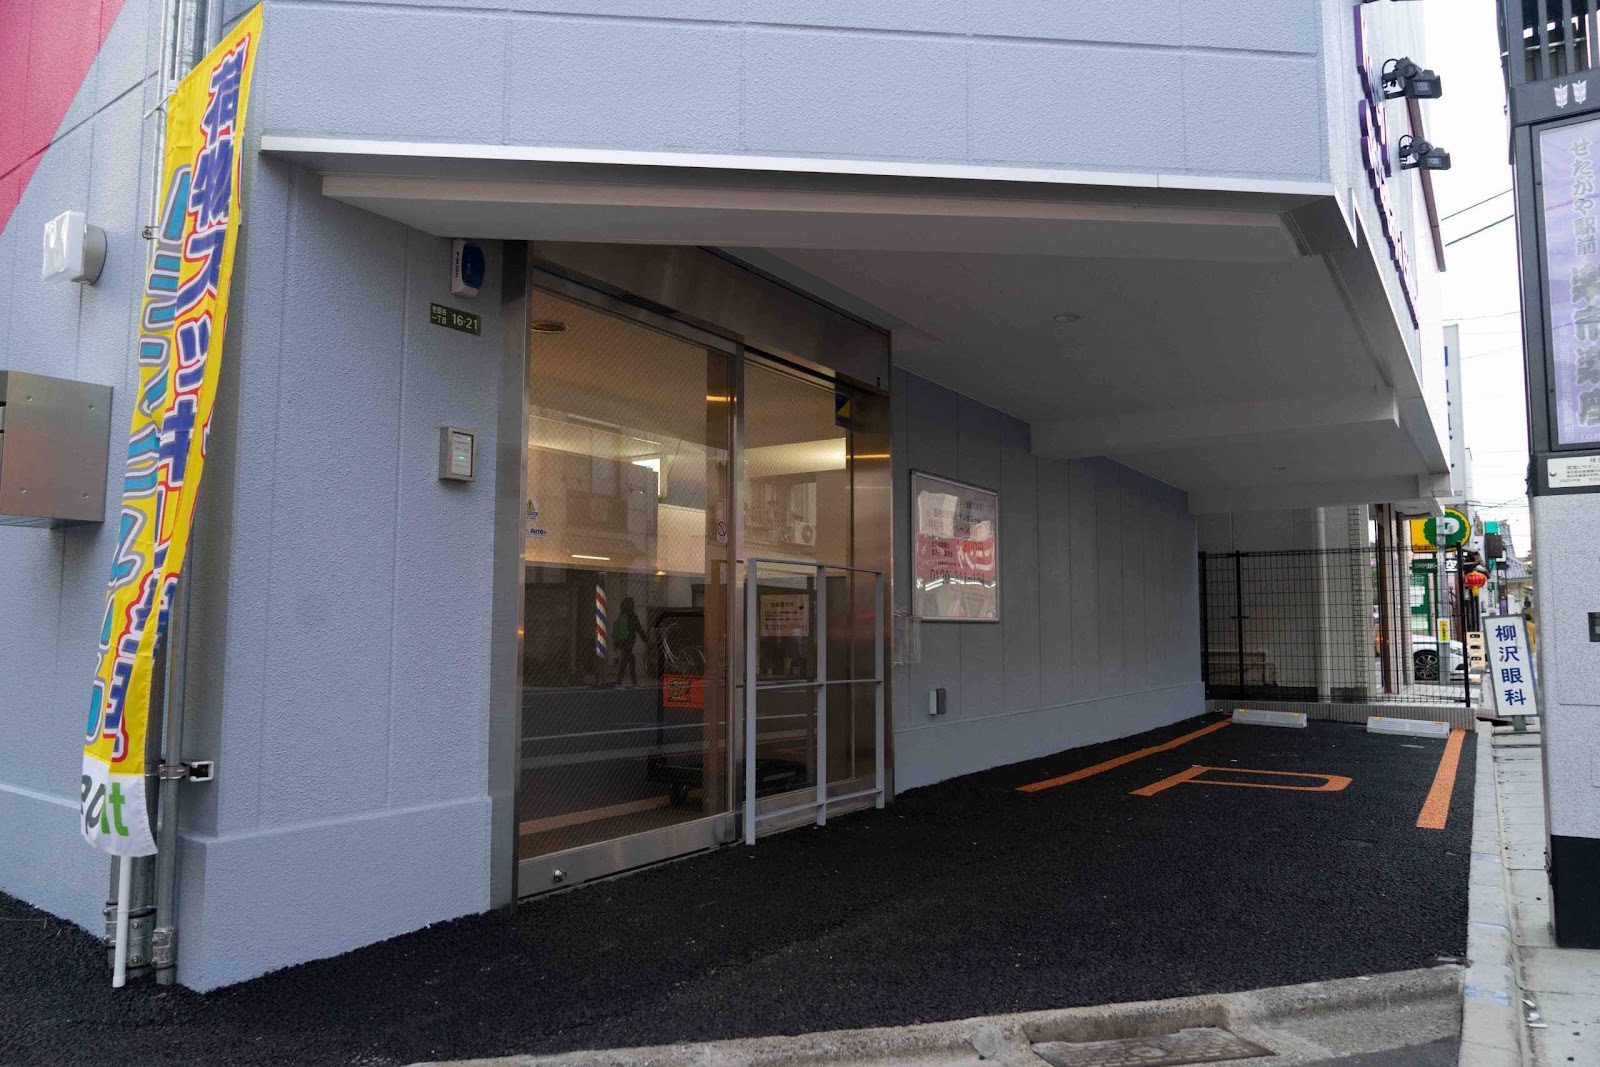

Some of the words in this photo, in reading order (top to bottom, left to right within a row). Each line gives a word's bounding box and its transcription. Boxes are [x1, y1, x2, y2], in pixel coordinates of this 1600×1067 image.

[452, 313, 478, 331] 16-21
[1495, 624, 1527, 706] 柳沢眼科
